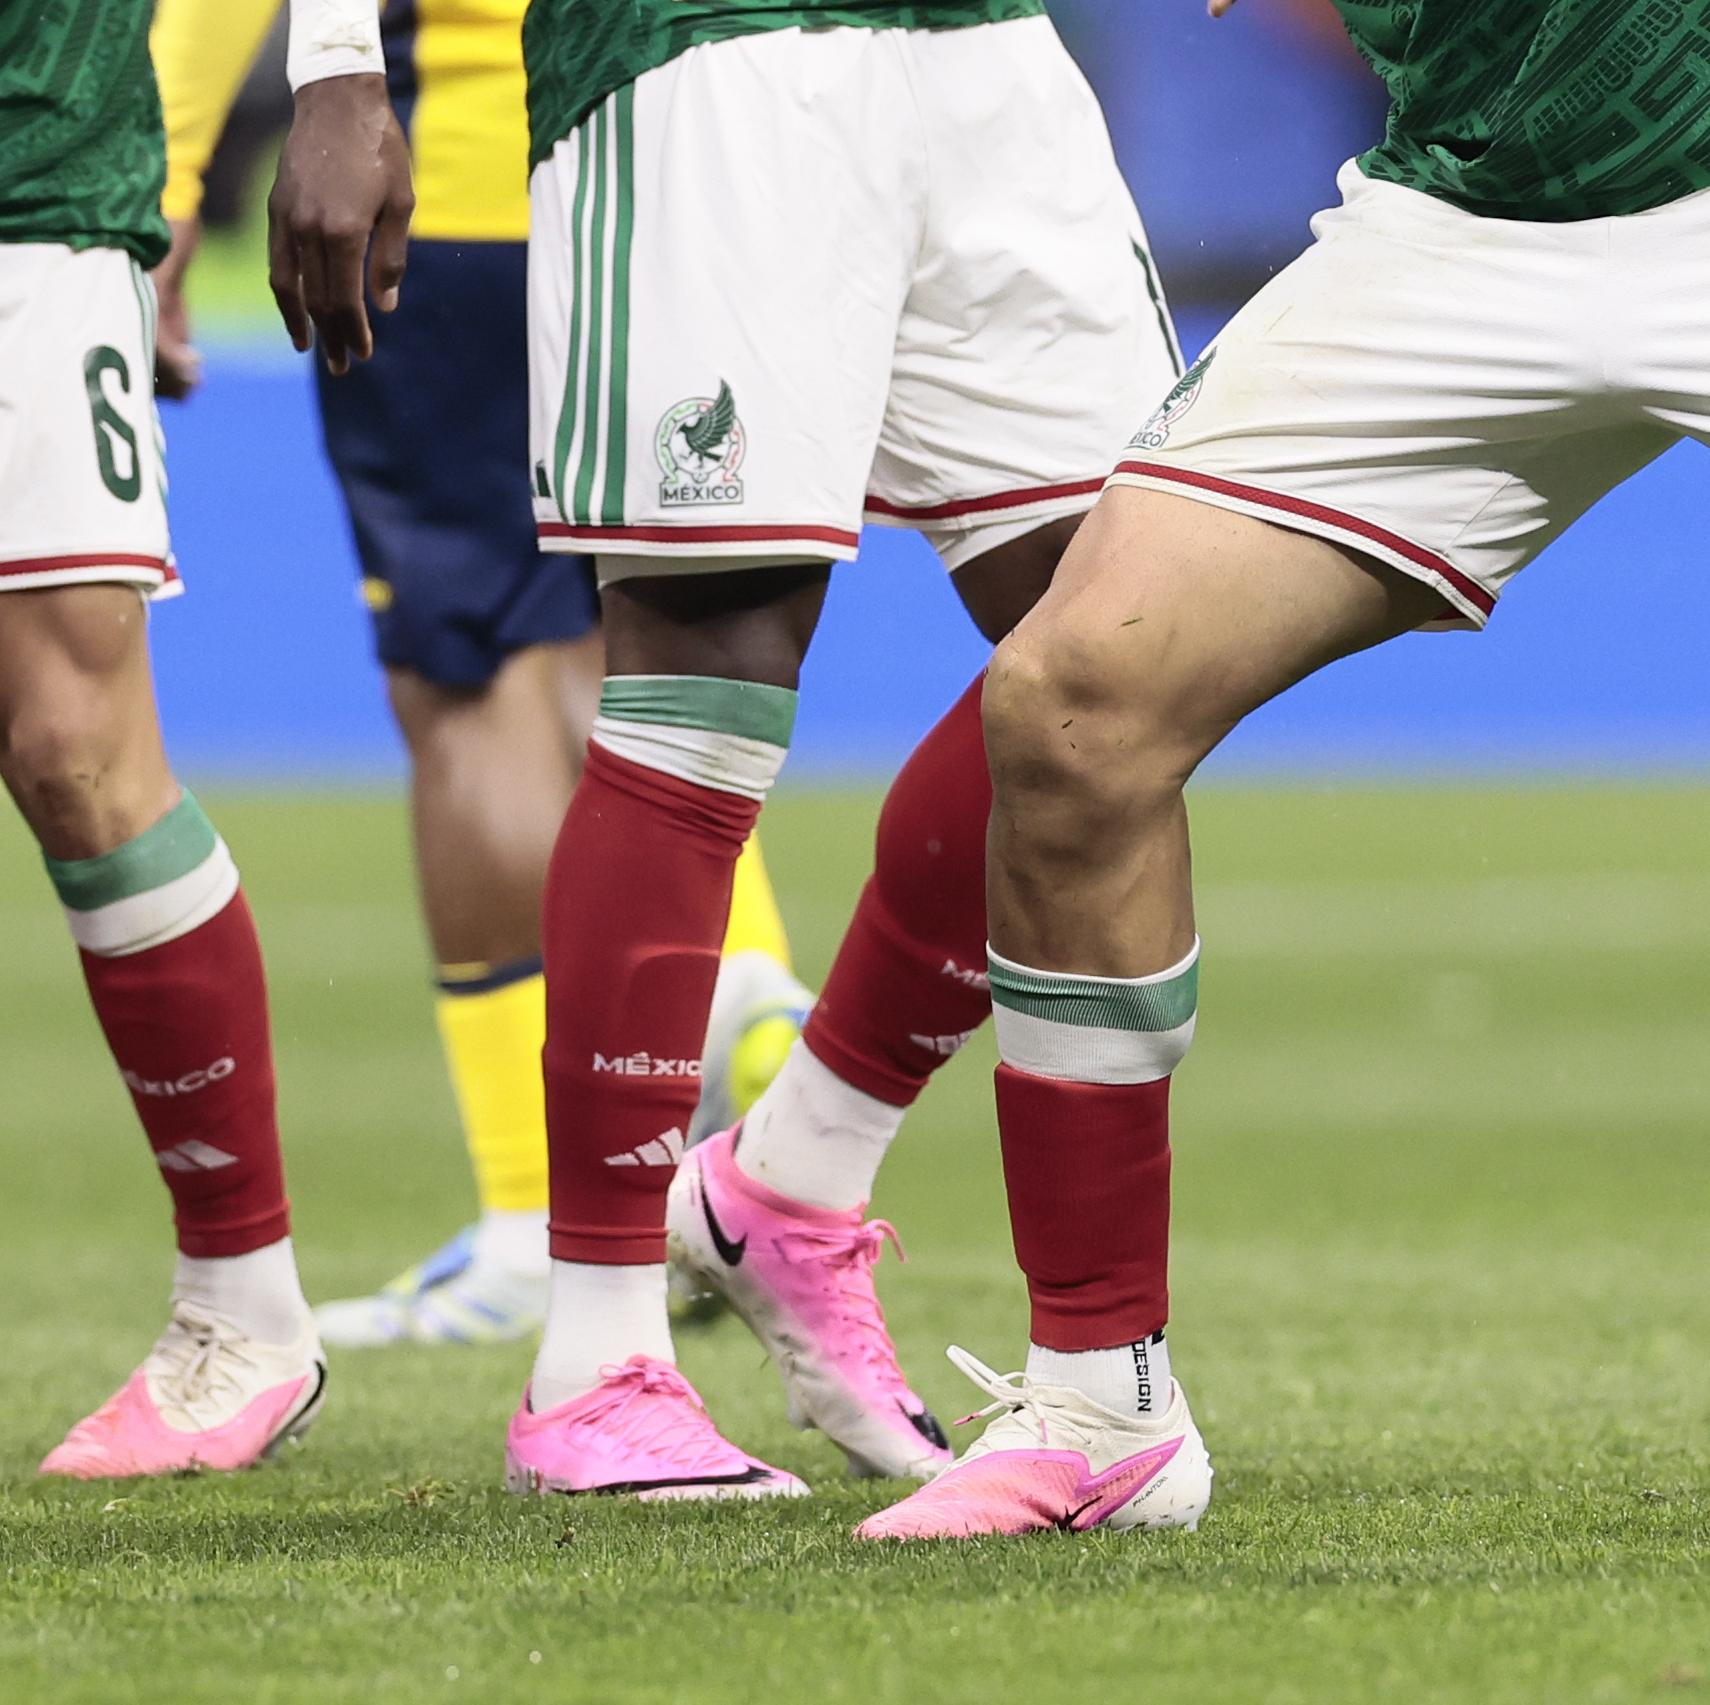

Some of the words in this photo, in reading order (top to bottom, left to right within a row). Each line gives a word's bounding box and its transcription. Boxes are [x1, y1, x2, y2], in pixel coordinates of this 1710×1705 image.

[84, 345, 142, 503] 6
[662, 482, 739, 501] MÉXICO
[121, 1056, 236, 1096] XICO
[1132, 1337, 1152, 1412] DESIGN
